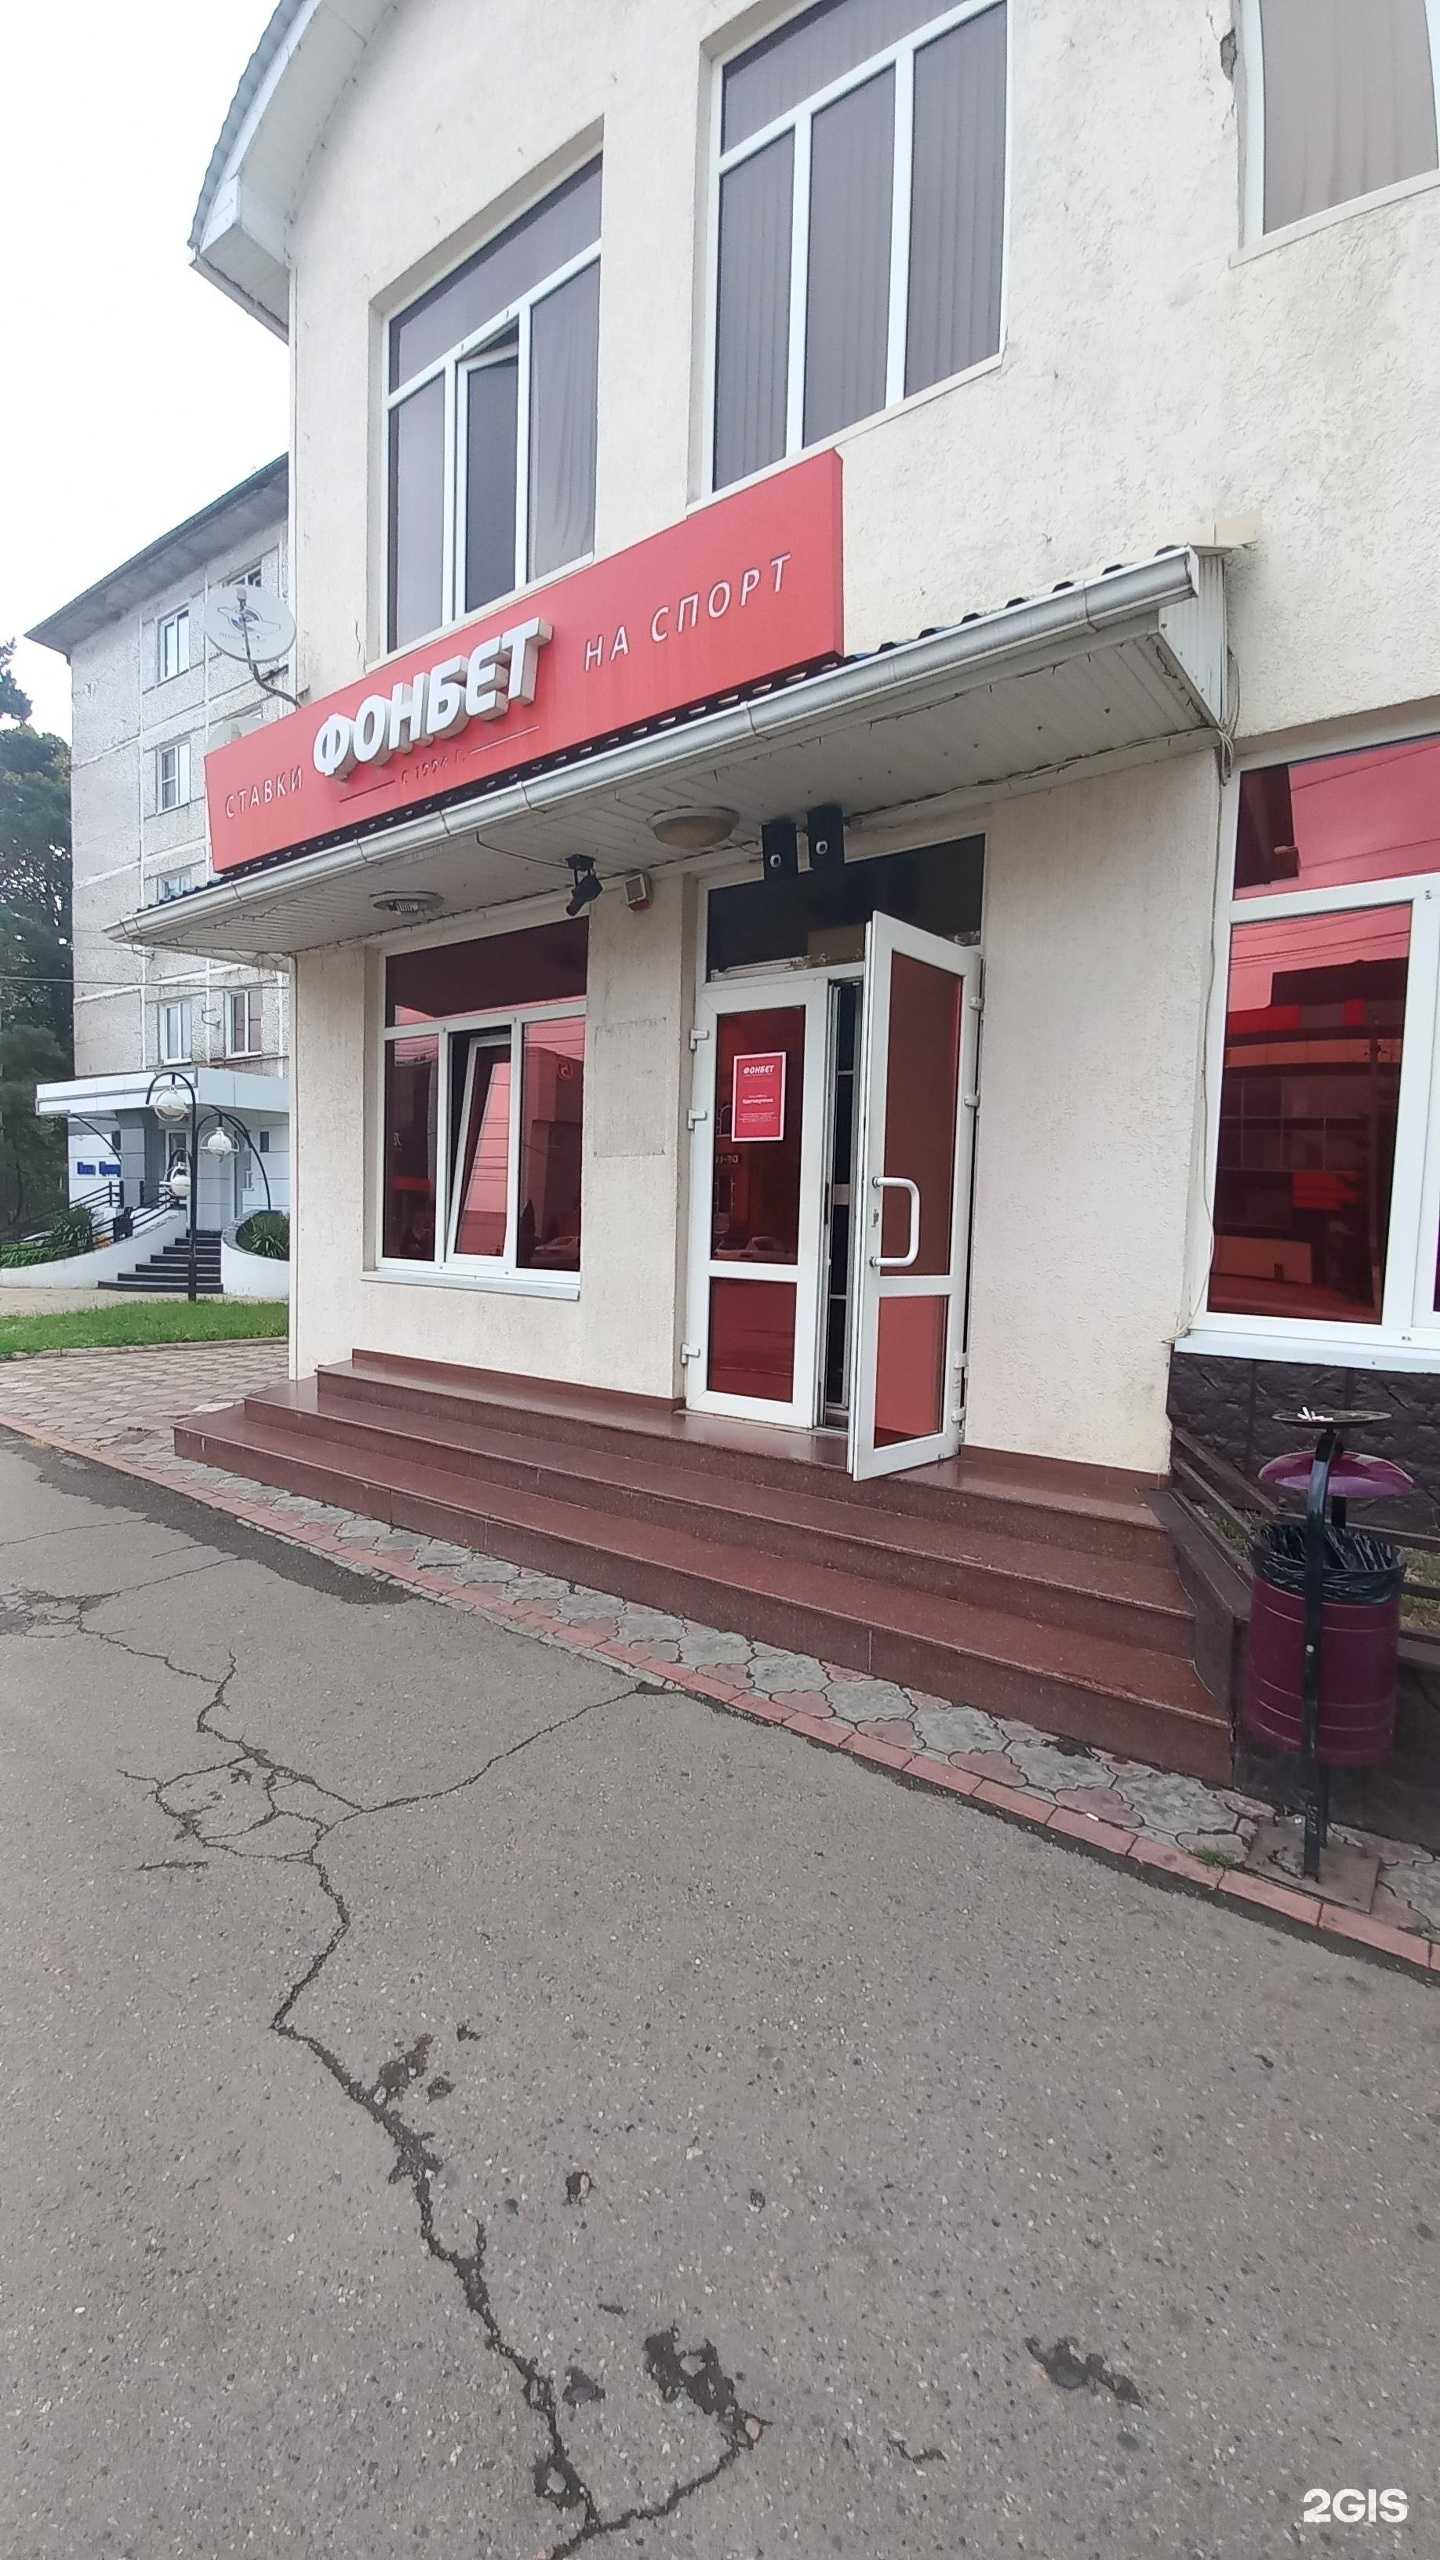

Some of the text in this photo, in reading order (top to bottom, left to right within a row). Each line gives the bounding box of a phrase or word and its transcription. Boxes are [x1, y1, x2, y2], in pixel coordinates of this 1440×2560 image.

[584, 552, 792, 672] НА СПОРТ
[313, 617, 549, 778] ФОНБЕТ
[225, 766, 303, 818] СТАВКИ
[743, 1064, 775, 1075] ФОНБЕТ
